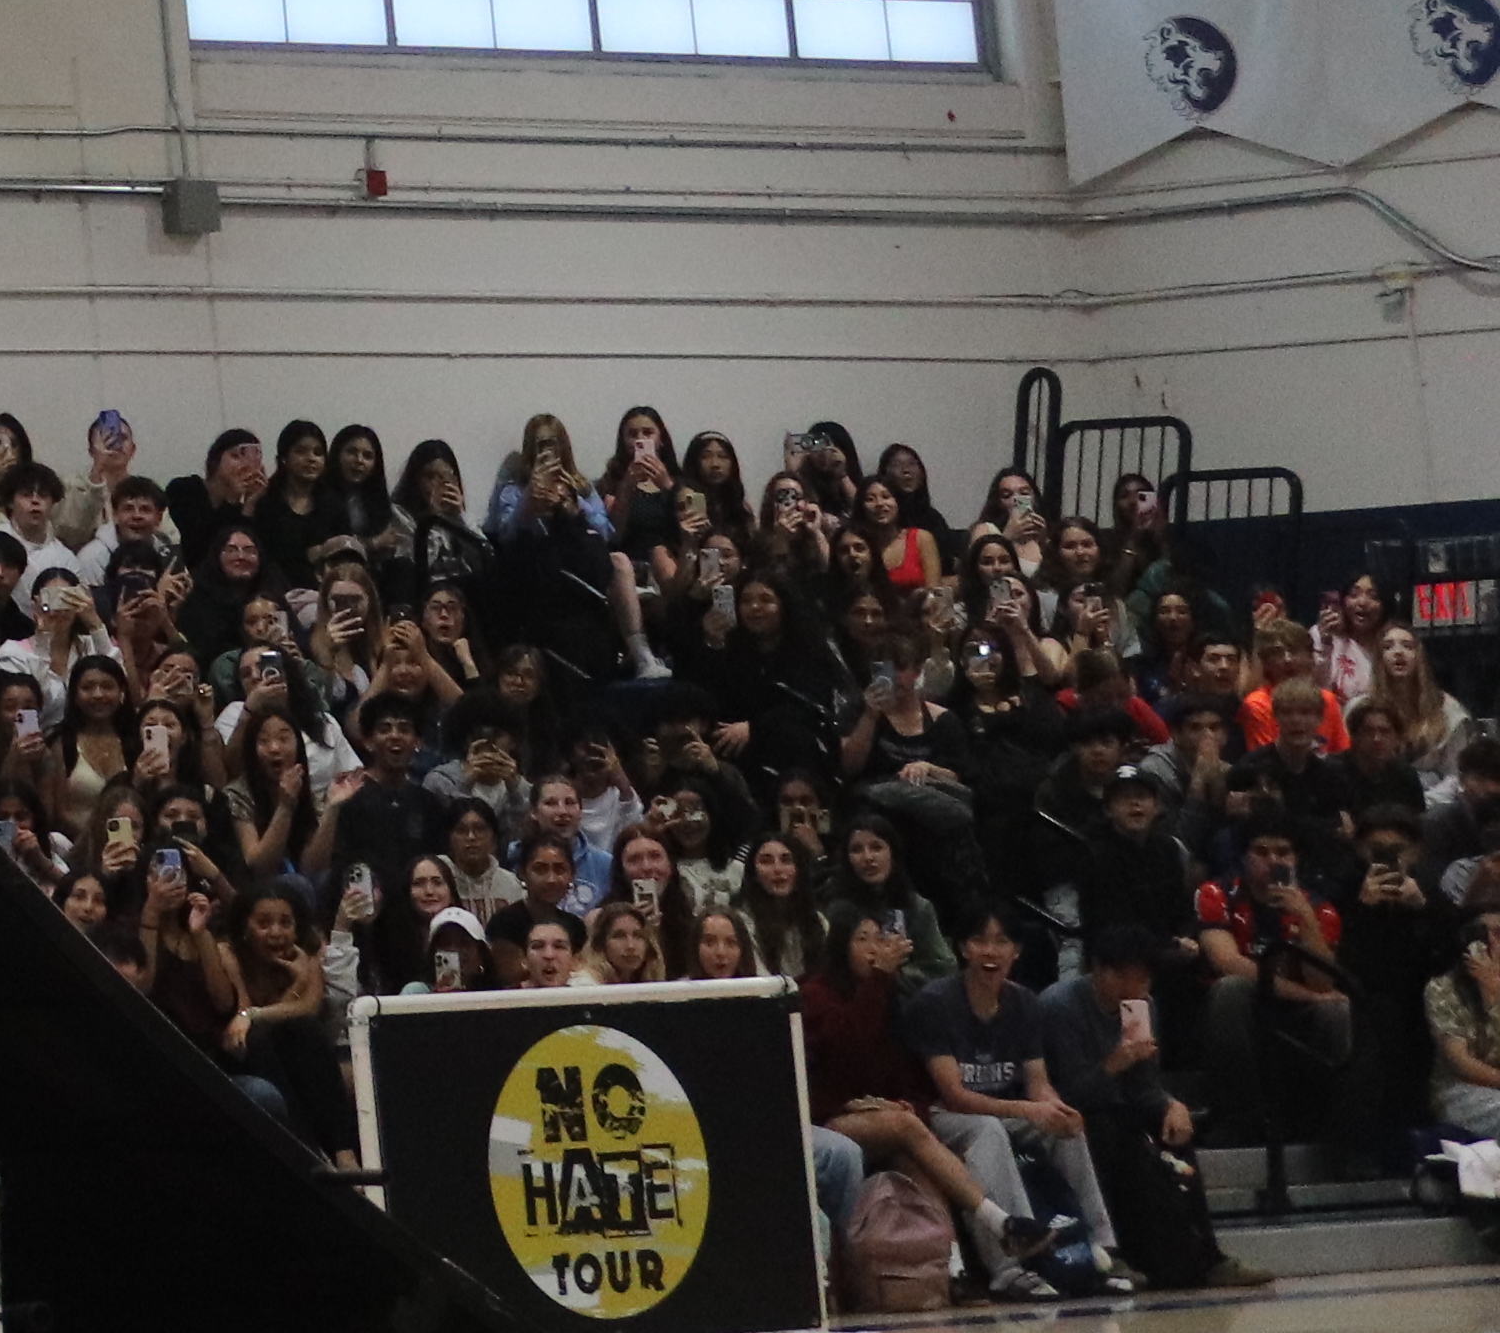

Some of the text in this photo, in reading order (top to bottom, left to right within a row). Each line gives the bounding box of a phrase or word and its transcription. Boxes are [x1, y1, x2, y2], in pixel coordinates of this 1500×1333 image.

[535, 1063, 648, 1142] NO
[520, 1145, 678, 1237] HATE
[552, 1248, 664, 1295] TOUR
